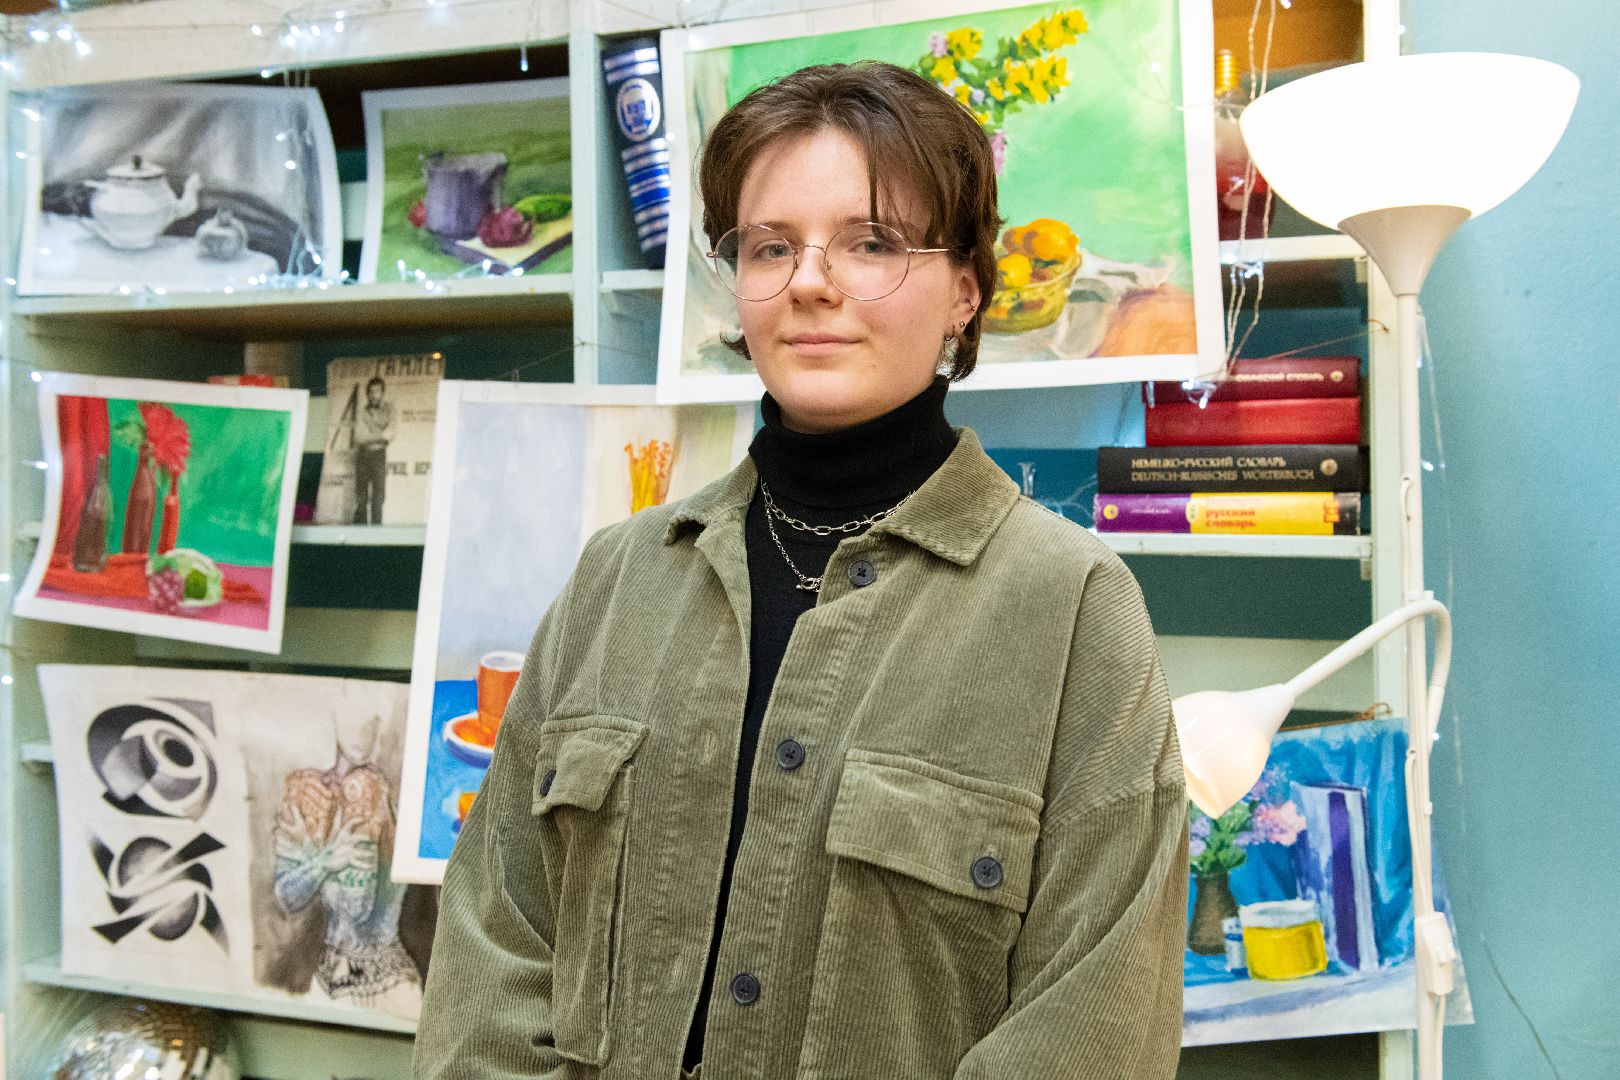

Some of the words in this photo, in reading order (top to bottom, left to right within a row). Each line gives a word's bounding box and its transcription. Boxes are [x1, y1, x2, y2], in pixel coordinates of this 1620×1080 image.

[1236, 456, 1287, 468] СЛОВАРЬ
[1205, 508, 1256, 520] русский
[1205, 519, 1257, 530] словарь
